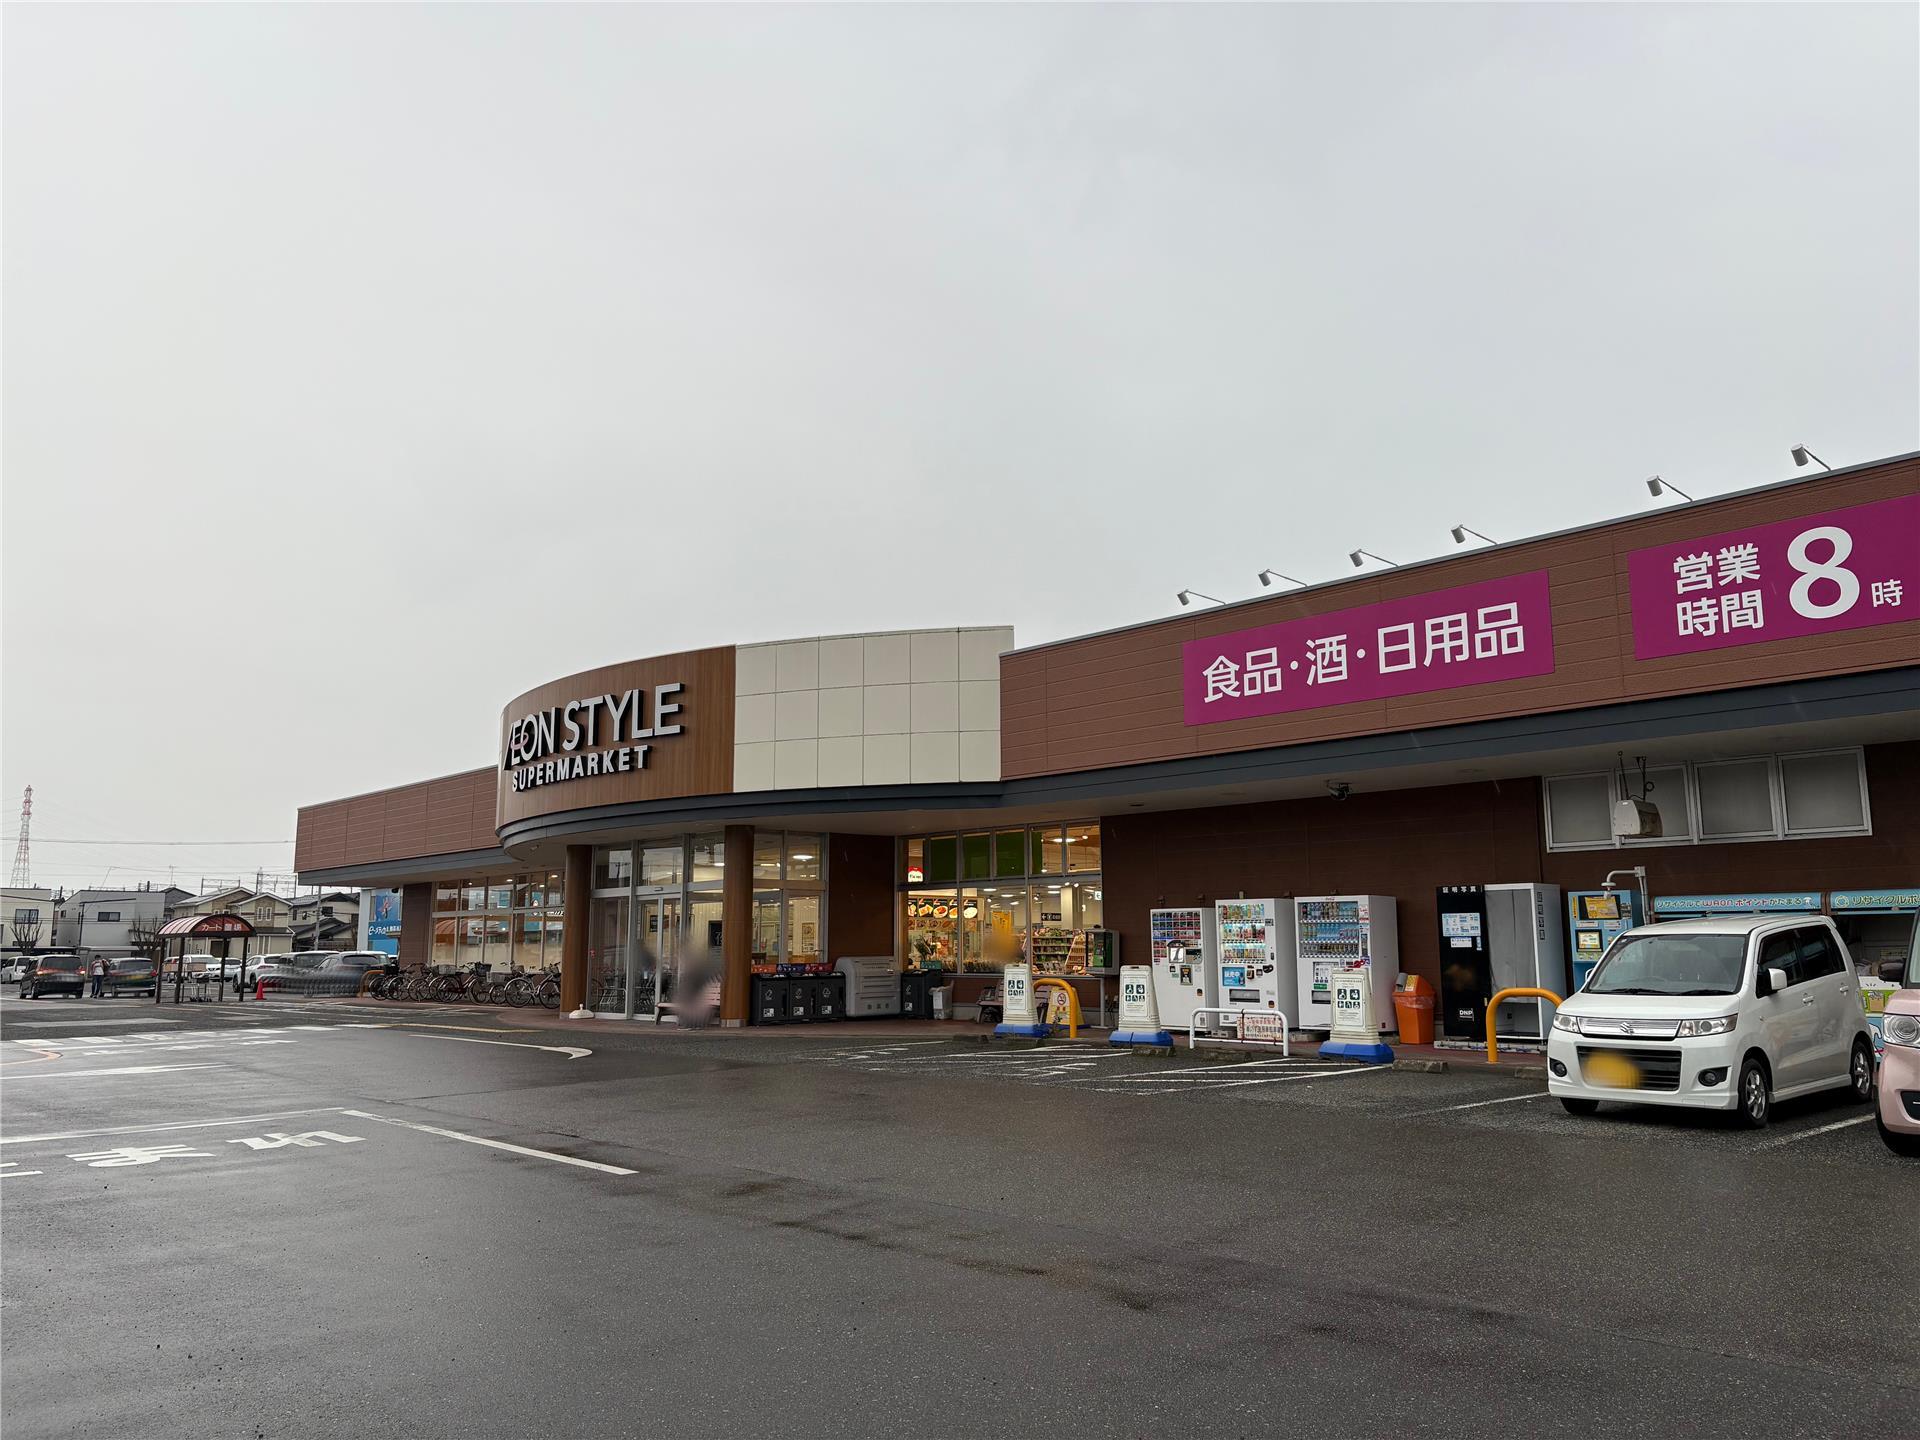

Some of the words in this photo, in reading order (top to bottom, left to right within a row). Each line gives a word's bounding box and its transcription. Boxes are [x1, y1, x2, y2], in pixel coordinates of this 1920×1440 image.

[1673, 542, 1761, 595] 営業
[1676, 589, 1765, 638] 時間
[562, 682, 684, 751] STYLE
[512, 744, 649, 793] SUPERMARKET
